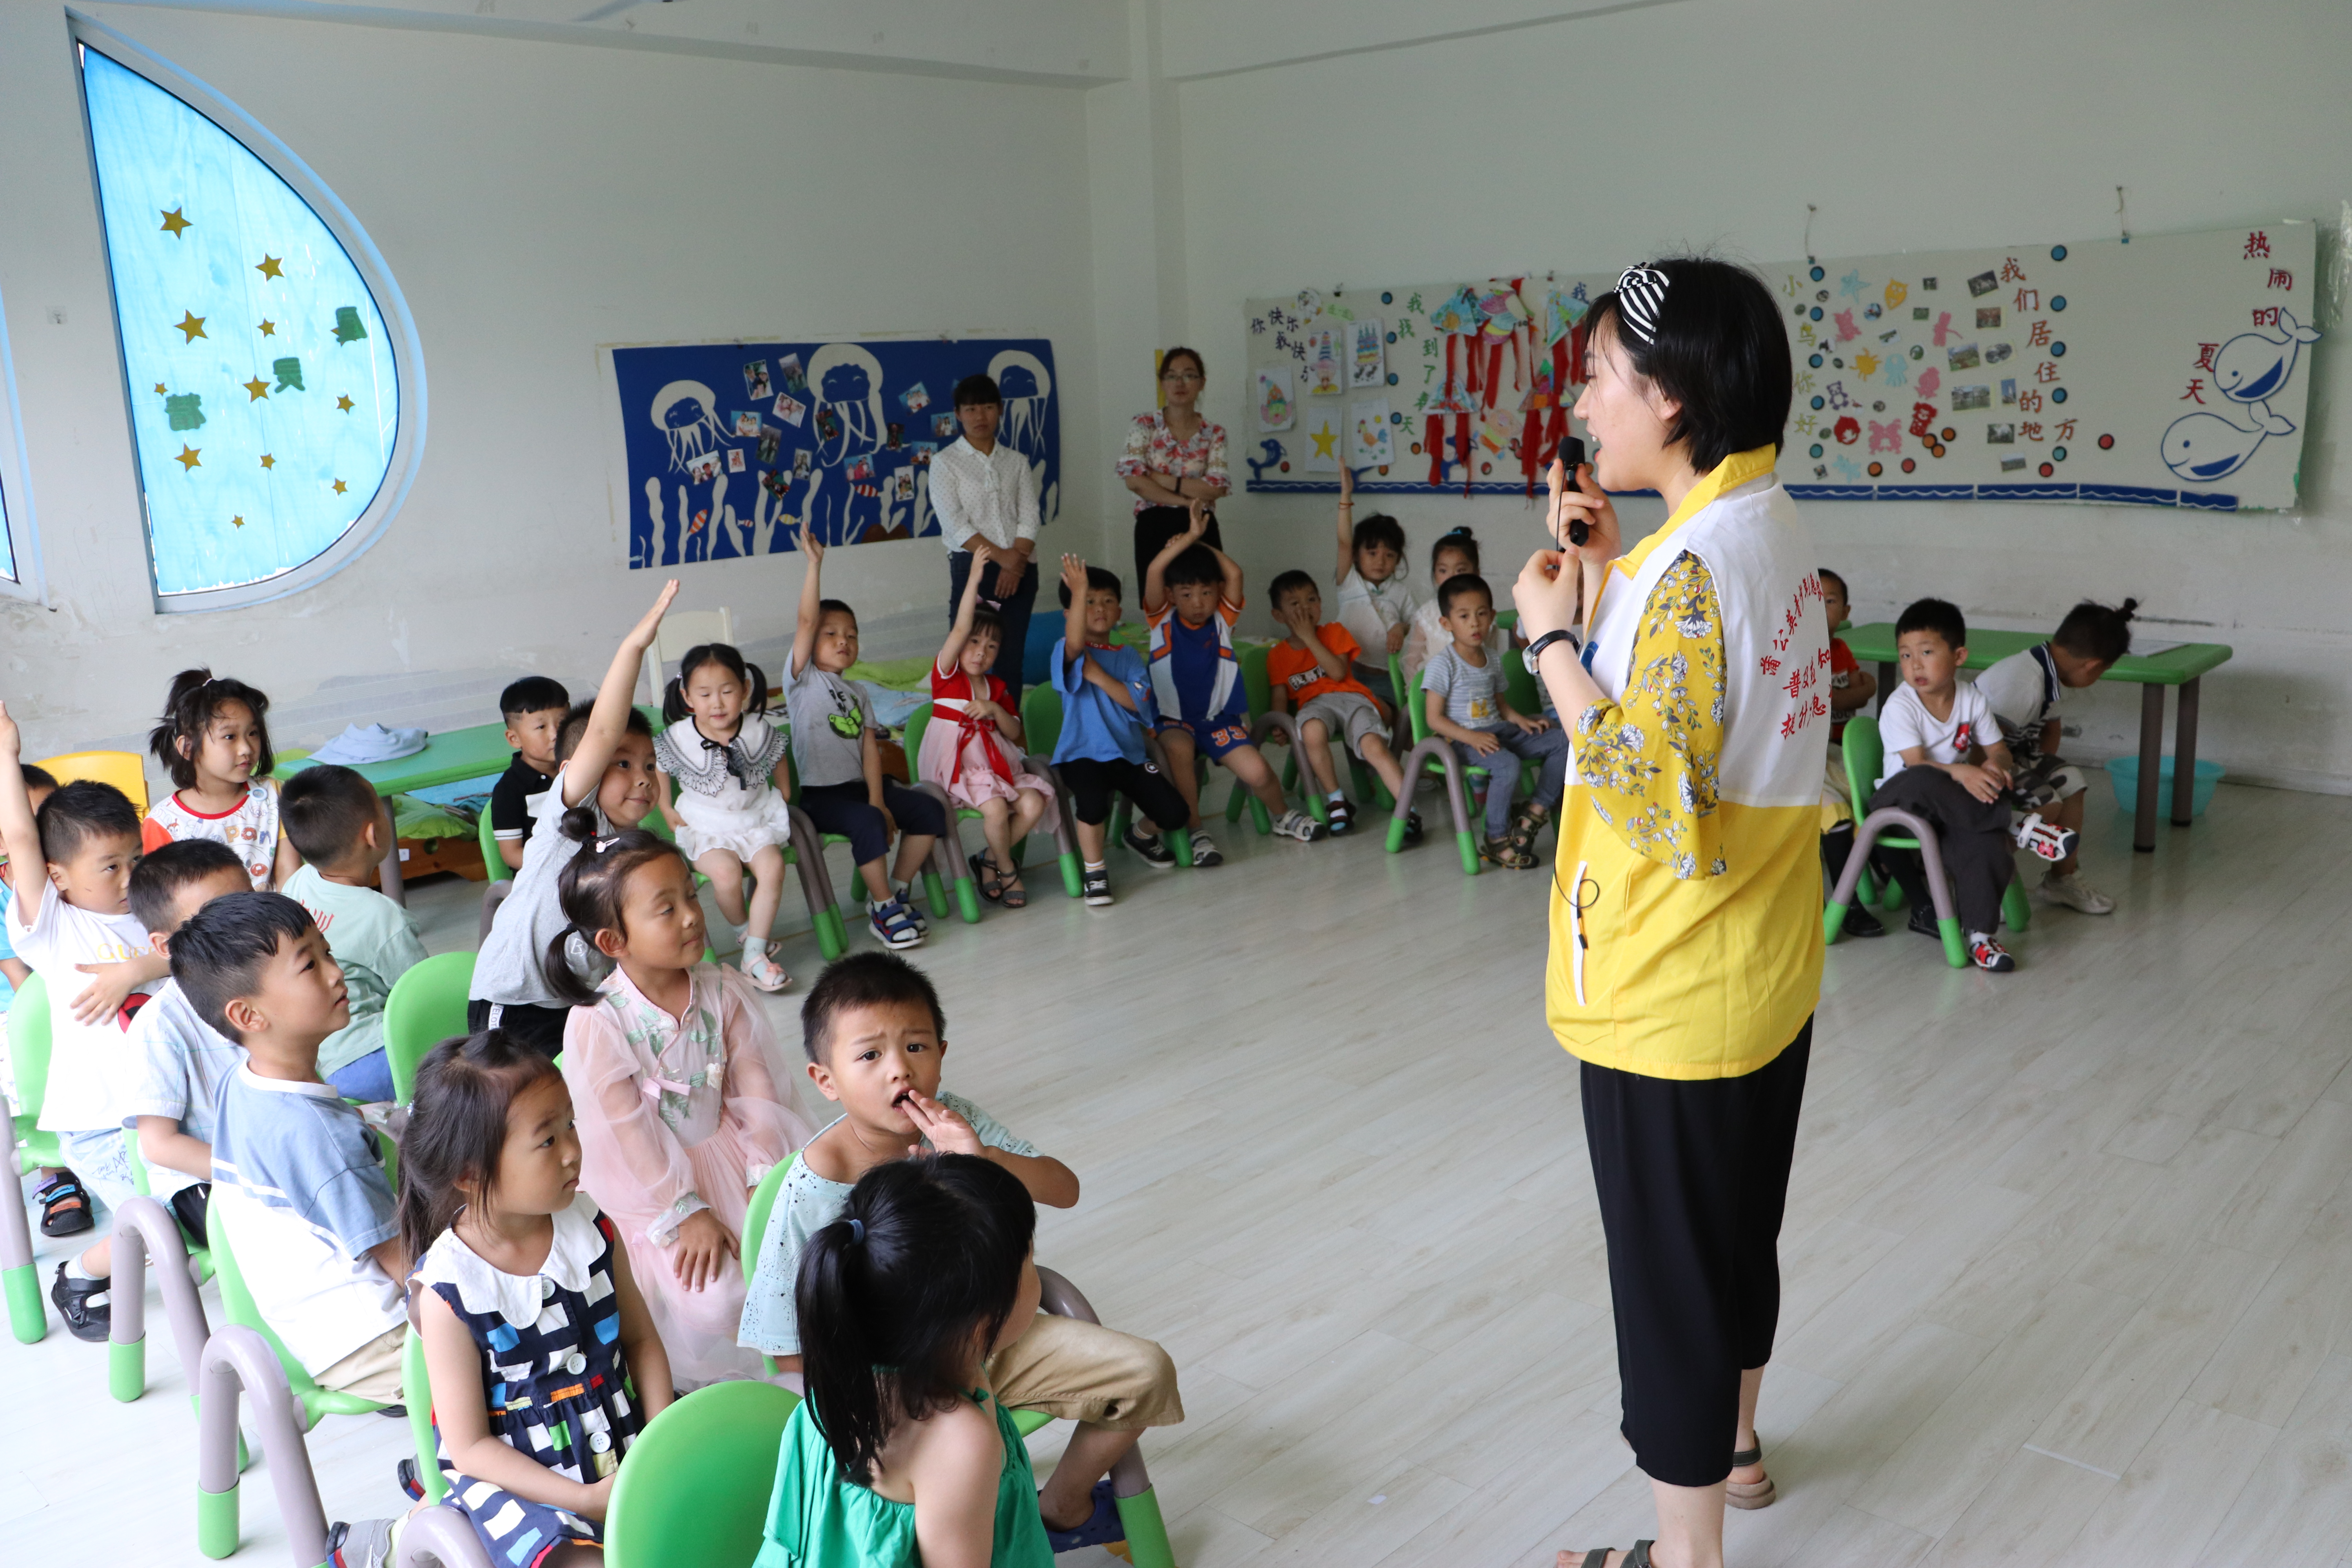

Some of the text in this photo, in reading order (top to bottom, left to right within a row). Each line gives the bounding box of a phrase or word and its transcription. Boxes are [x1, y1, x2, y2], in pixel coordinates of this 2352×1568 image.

[1782, 275, 1818, 435] 小鸟你好
[2000, 258, 2078, 442] 我们居住的地方
[2180, 231, 2292, 404] 热闹的夏天
[1211, 724, 1247, 747] 33
